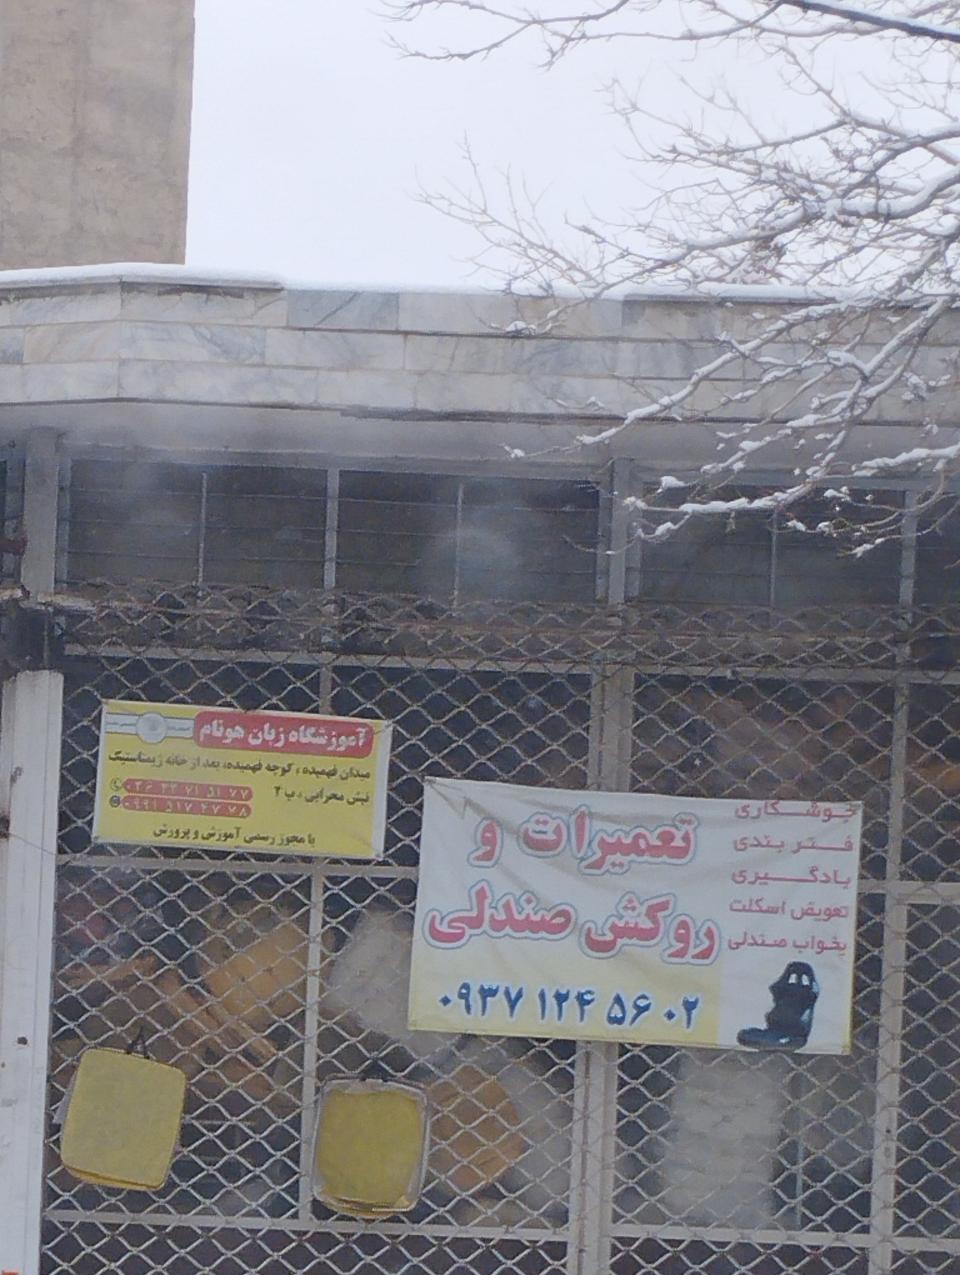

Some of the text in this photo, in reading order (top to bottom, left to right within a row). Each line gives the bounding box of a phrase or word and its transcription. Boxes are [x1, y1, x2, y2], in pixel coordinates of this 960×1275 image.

[248, 722, 286, 748] زبان
[288, 725, 368, 751] آموزشگاه
[201, 825, 243, 842] آموزش
[307, 832, 316, 847] با
[472, 809, 696, 872] تعمیرات و
[729, 897, 850, 922] تعویض اسکلت
[427, 884, 718, 962] روکش صندلی
[728, 930, 788, 951] صندلی
